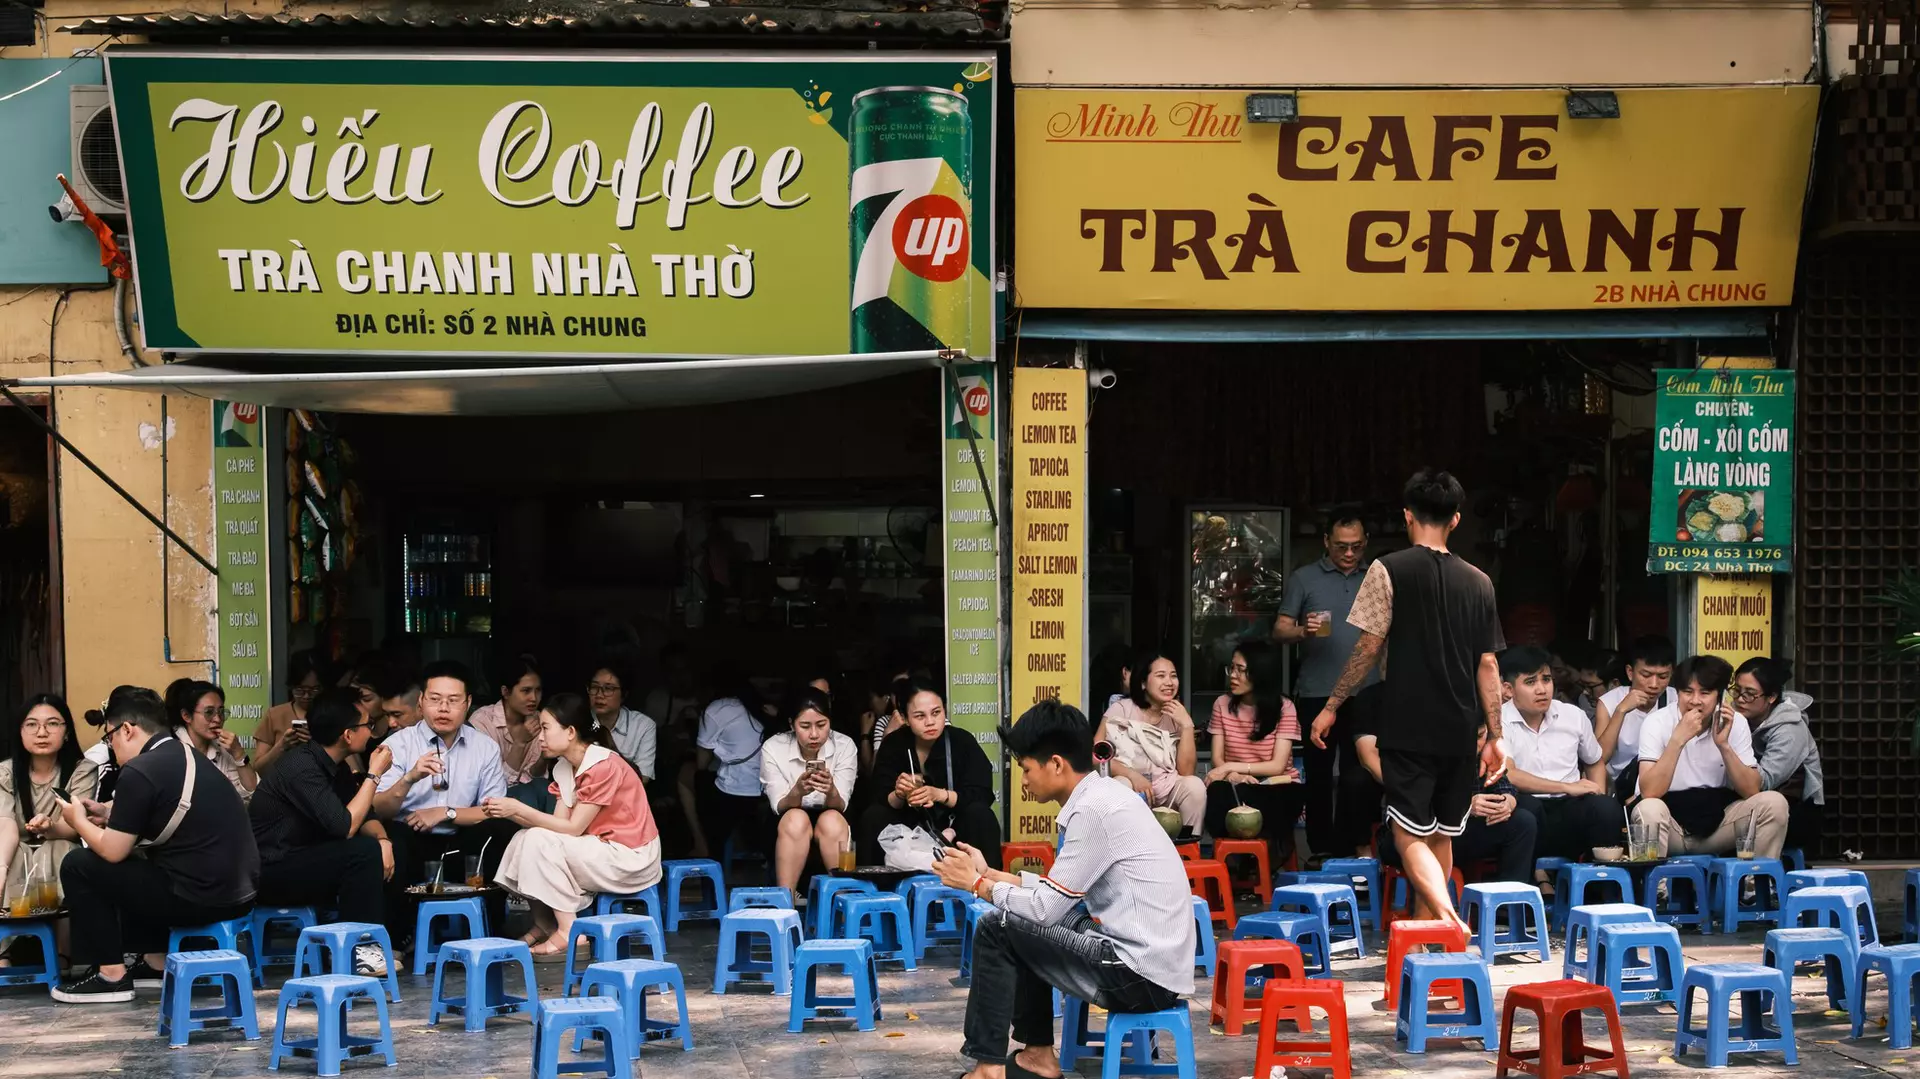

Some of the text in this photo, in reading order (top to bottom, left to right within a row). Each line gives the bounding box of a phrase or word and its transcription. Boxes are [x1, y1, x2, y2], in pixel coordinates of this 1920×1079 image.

[1047, 103, 1158, 138] Minh
[1277, 114, 1559, 181] CAFE
[169, 98, 810, 230] Hiếu Coffee
[851, 156, 963, 311] 7 up
[1080, 192, 1745, 280] TRÀ CHANH
[218, 239, 754, 298] TRÀ CHANH NHÀ THỜ
[1593, 281, 1766, 303] 2B NHÀ CHUNG
[336, 307, 647, 337] ĐỊA CHỈ: SỐ 2 NHÀ CHUNG
[1032, 392, 1067, 411] COFFEE
[1695, 399, 1754, 417] CHUYÊN:
[1022, 425, 1076, 443] LEMON TEA
[1659, 419, 1698, 452] CỐM
[1715, 425, 1742, 452] XÔI
[1748, 420, 1788, 452] CỐM
[1029, 457, 1069, 476] TAPIOCA
[1674, 457, 1770, 487] LÀNG VÒNG
[952, 479, 977, 493] LEMON
[236, 490, 261, 503] CHANH
[1026, 490, 1071, 509] STARLING
[1028, 523, 1069, 542] APRICOT
[953, 538, 993, 552] PEACH TEA
[1682, 547, 1708, 558] 094
[1714, 548, 1740, 559] 653
[1747, 548, 1781, 559] 1976
[1019, 556, 1077, 574] SALT LEMON
[1693, 561, 1710, 571] 24
[951, 569, 984, 582] TAMARIND
[958, 597, 990, 611] TAPIOCA
[1032, 588, 1063, 607] SRESH
[1703, 589, 1765, 616] CHANH MUỐI
[1030, 621, 1064, 639] LEMON
[969, 643, 979, 655] ICE
[1705, 631, 1738, 650] CHANH
[1028, 653, 1066, 672] ORANGE
[1020, 816, 1051, 834] PEACH
[1442, 1027, 1460, 1037] 24
[1294, 1056, 1312, 1065] 24
